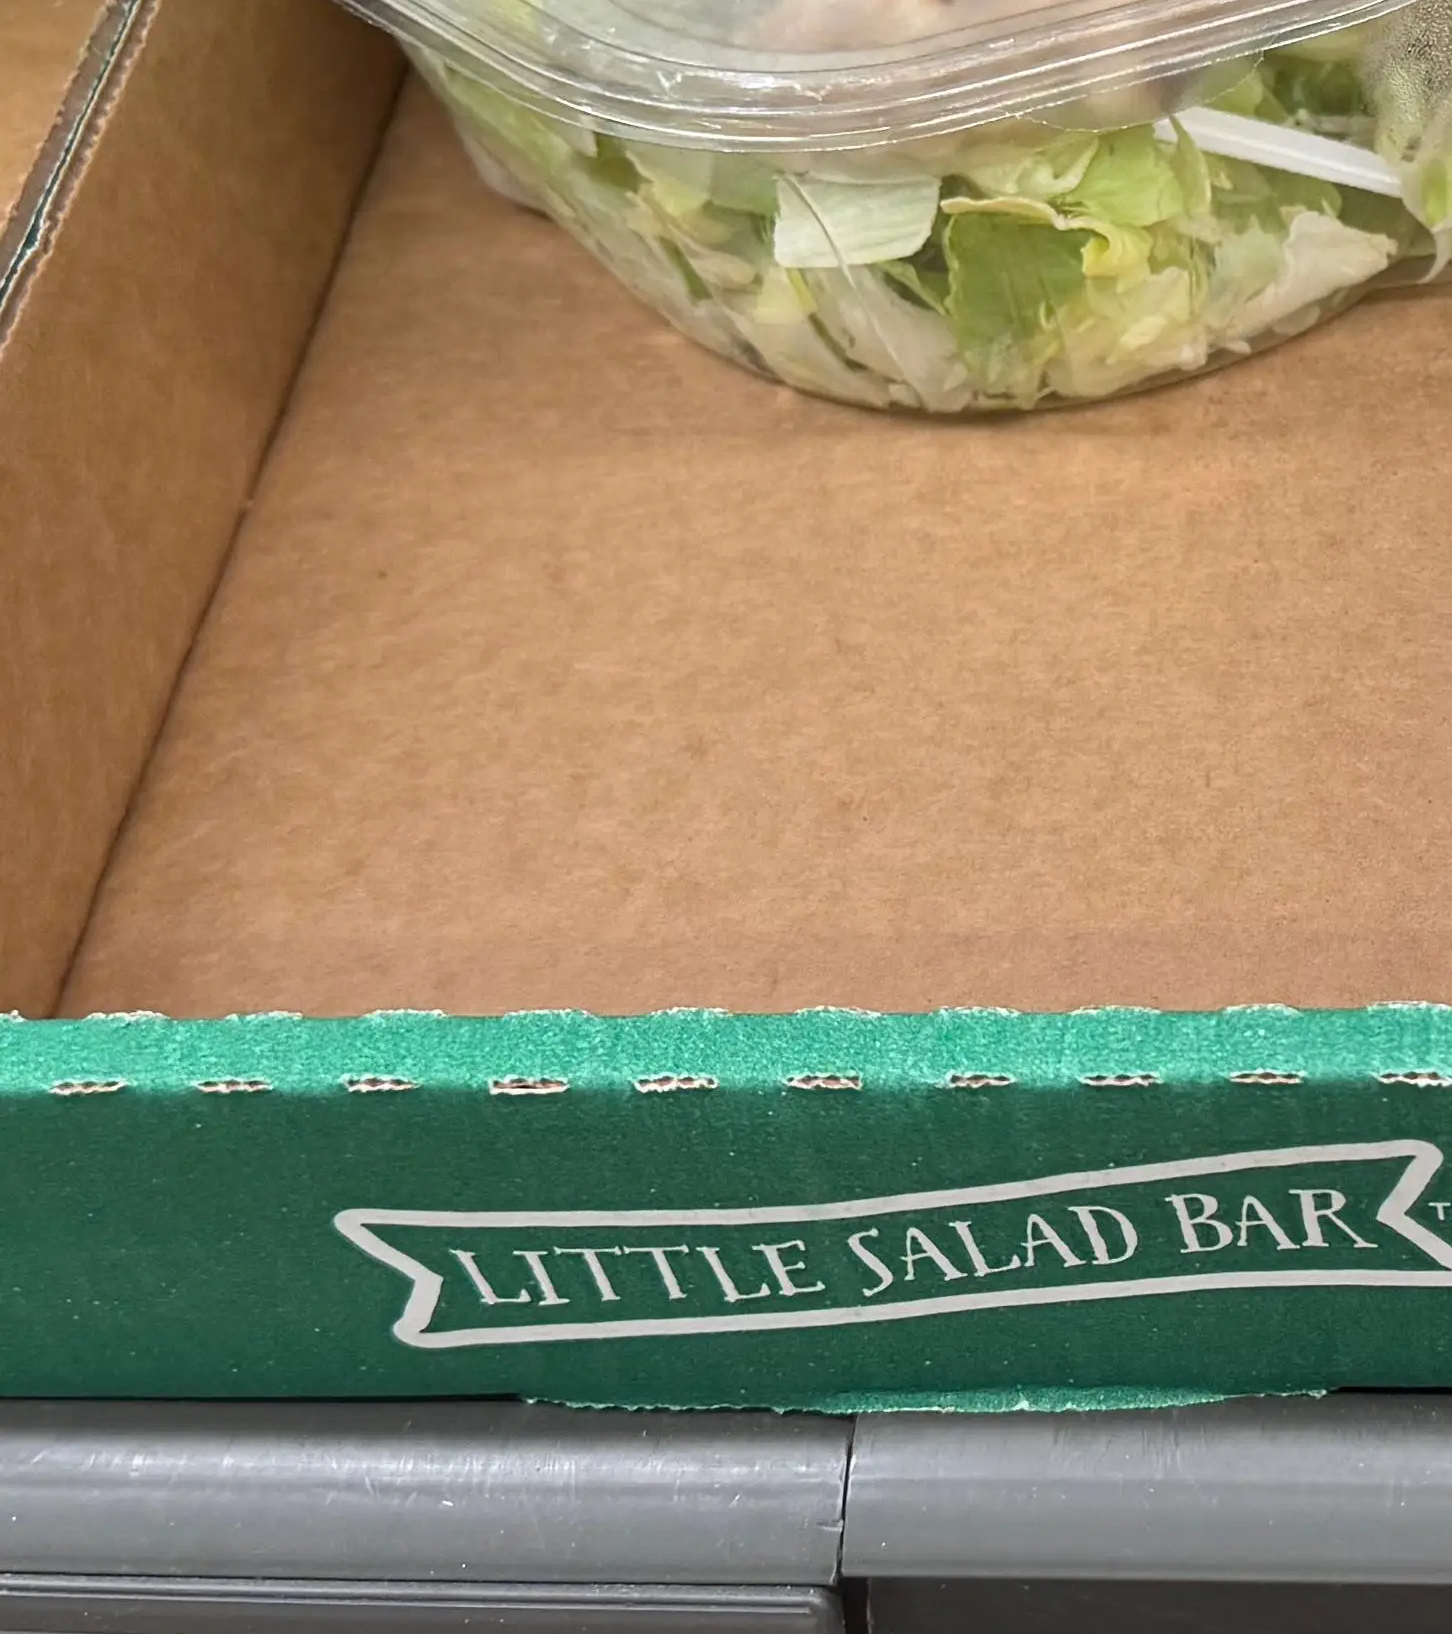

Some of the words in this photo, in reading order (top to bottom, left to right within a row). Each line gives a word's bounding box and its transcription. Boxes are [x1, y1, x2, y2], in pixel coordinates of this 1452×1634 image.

[449, 1239, 826, 1306] LITTLE
[846, 1202, 1139, 1299] SALAD
[1164, 1185, 1380, 1255] BAR
